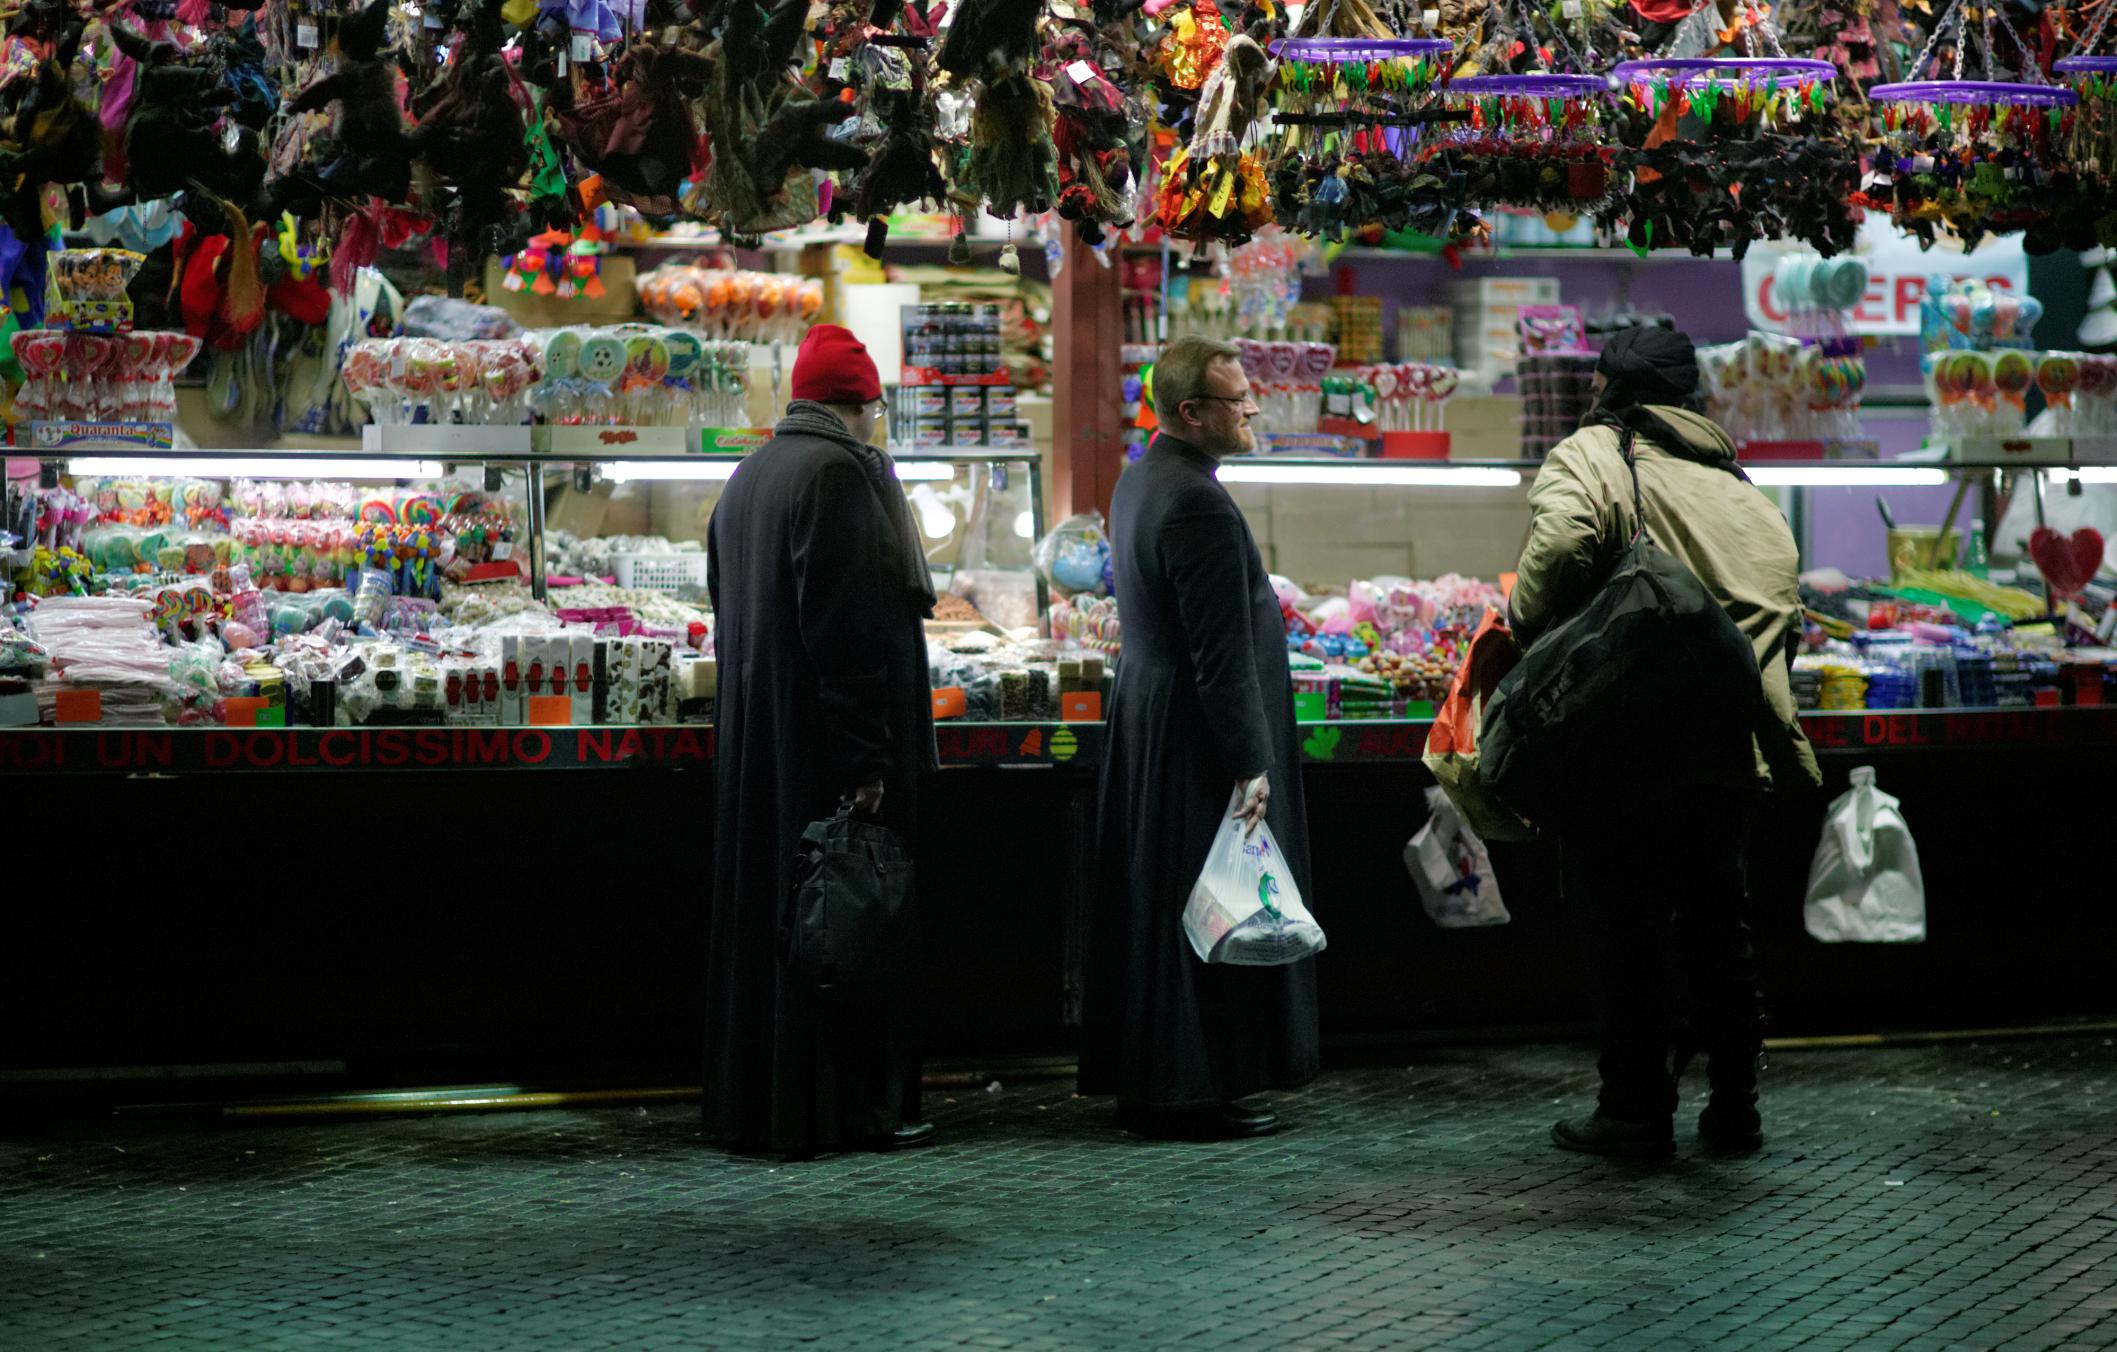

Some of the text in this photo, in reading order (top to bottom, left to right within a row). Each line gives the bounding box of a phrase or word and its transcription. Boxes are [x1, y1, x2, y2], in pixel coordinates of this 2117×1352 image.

[1862, 714, 1931, 745] DEL
[96, 731, 173, 766] UN
[204, 728, 552, 766] DOLCISSIMO
